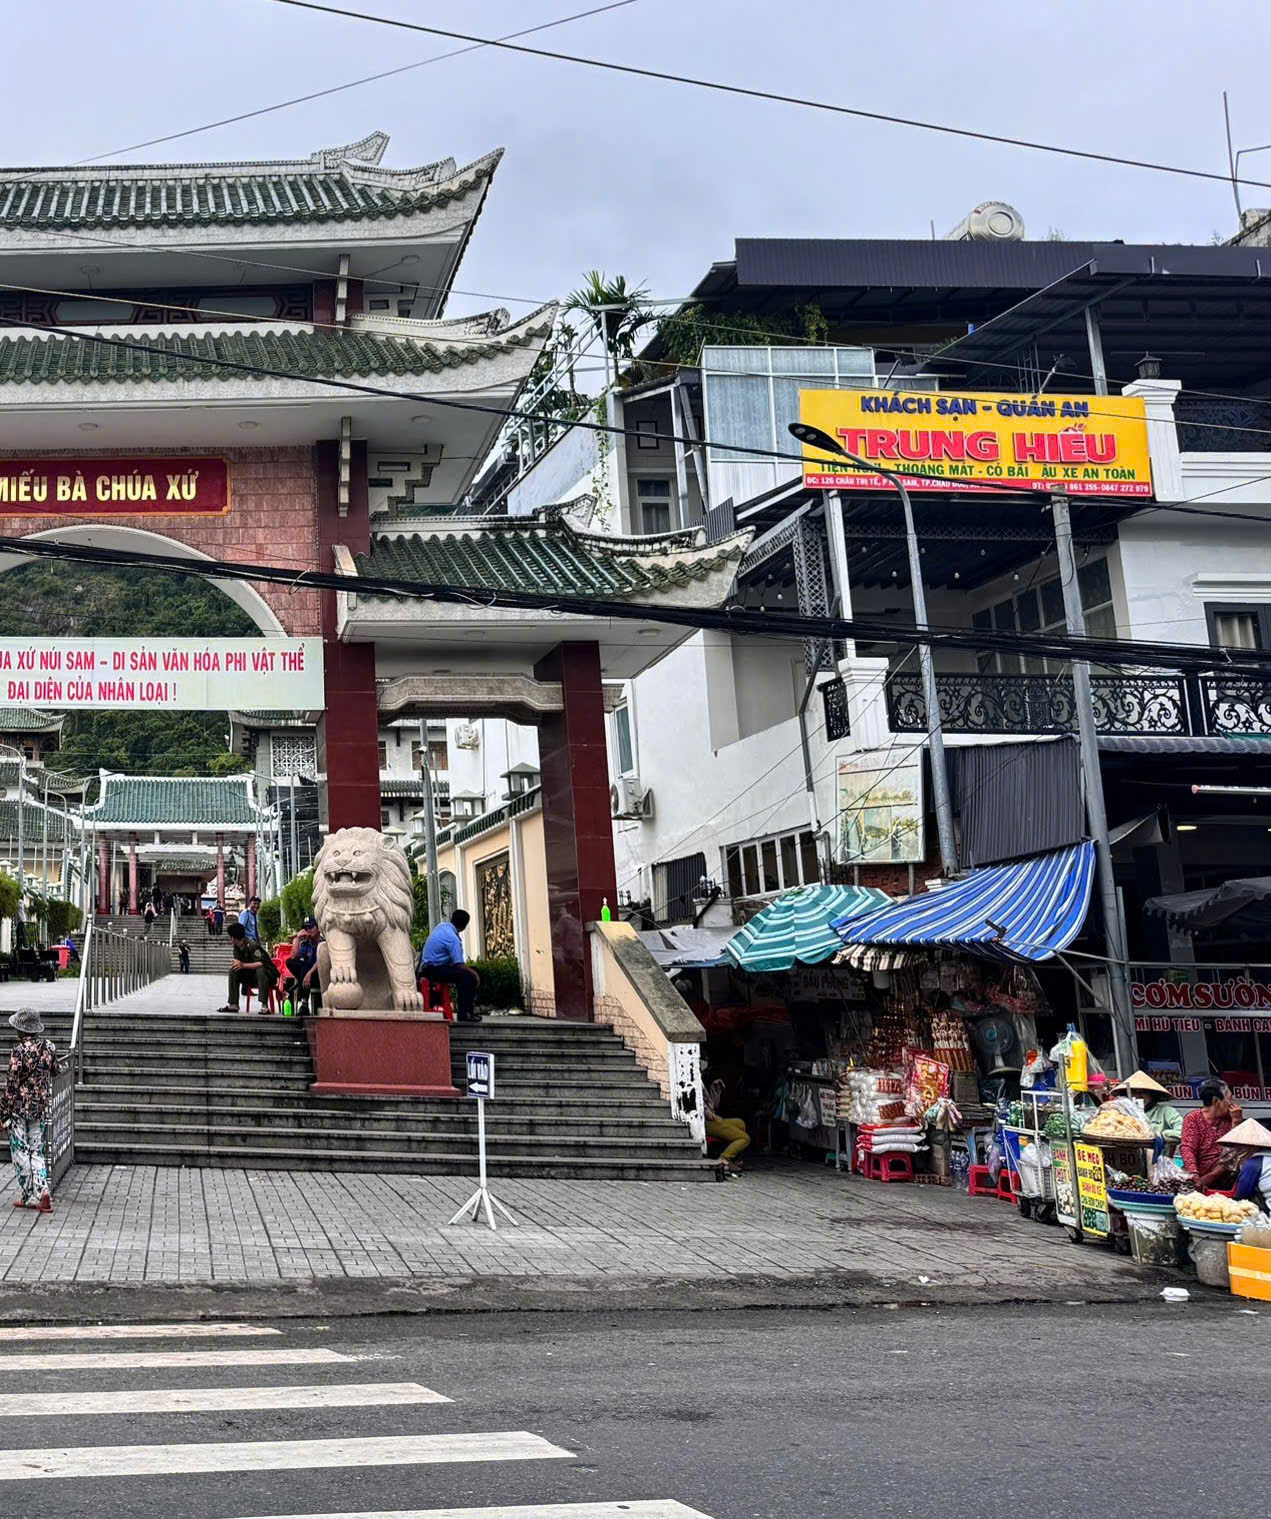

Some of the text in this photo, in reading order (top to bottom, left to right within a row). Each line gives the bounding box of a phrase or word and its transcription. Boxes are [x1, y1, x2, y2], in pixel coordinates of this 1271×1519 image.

[860, 391, 931, 414] KHÁCH
[936, 397, 977, 422] SẠN
[996, 394, 1055, 416] QUÁN
[836, 421, 1118, 465] TRUNG HIẾU
[56, 470, 87, 502] BÀ
[95, 469, 157, 501] CHÚA
[166, 468, 200, 501] XỨ
[894, 460, 944, 475] THOÁNG
[949, 462, 974, 476] MÁT
[986, 462, 1003, 476] CÓ
[1007, 464, 1028, 478] BÃI
[1063, 467, 1078, 478] XE
[1104, 465, 1136, 480] TOÀN
[17, 646, 36, 671] XỨ
[40, 647, 61, 671] NÚI
[66, 651, 95, 671] SAM
[113, 651, 125, 671] DI
[130, 646, 157, 671] SẢN
[162, 648, 189, 672] VĂN
[193, 647, 220, 672] HÓA
[225, 652, 247, 672] PHI
[251, 647, 276, 675] VẬT
[280, 643, 305, 672] THỂ
[8, 681, 28, 704] ĐẠI
[34, 676, 62, 704] DIỆN
[67, 675, 93, 701] CỦA
[98, 677, 135, 701] NHÂN
[139, 682, 168, 705] LOẠI
[1131, 978, 1193, 1008] CƠM
[1215, 1016, 1251, 1032] BÁNH
[1233, 1084, 1261, 1100] BÚN
